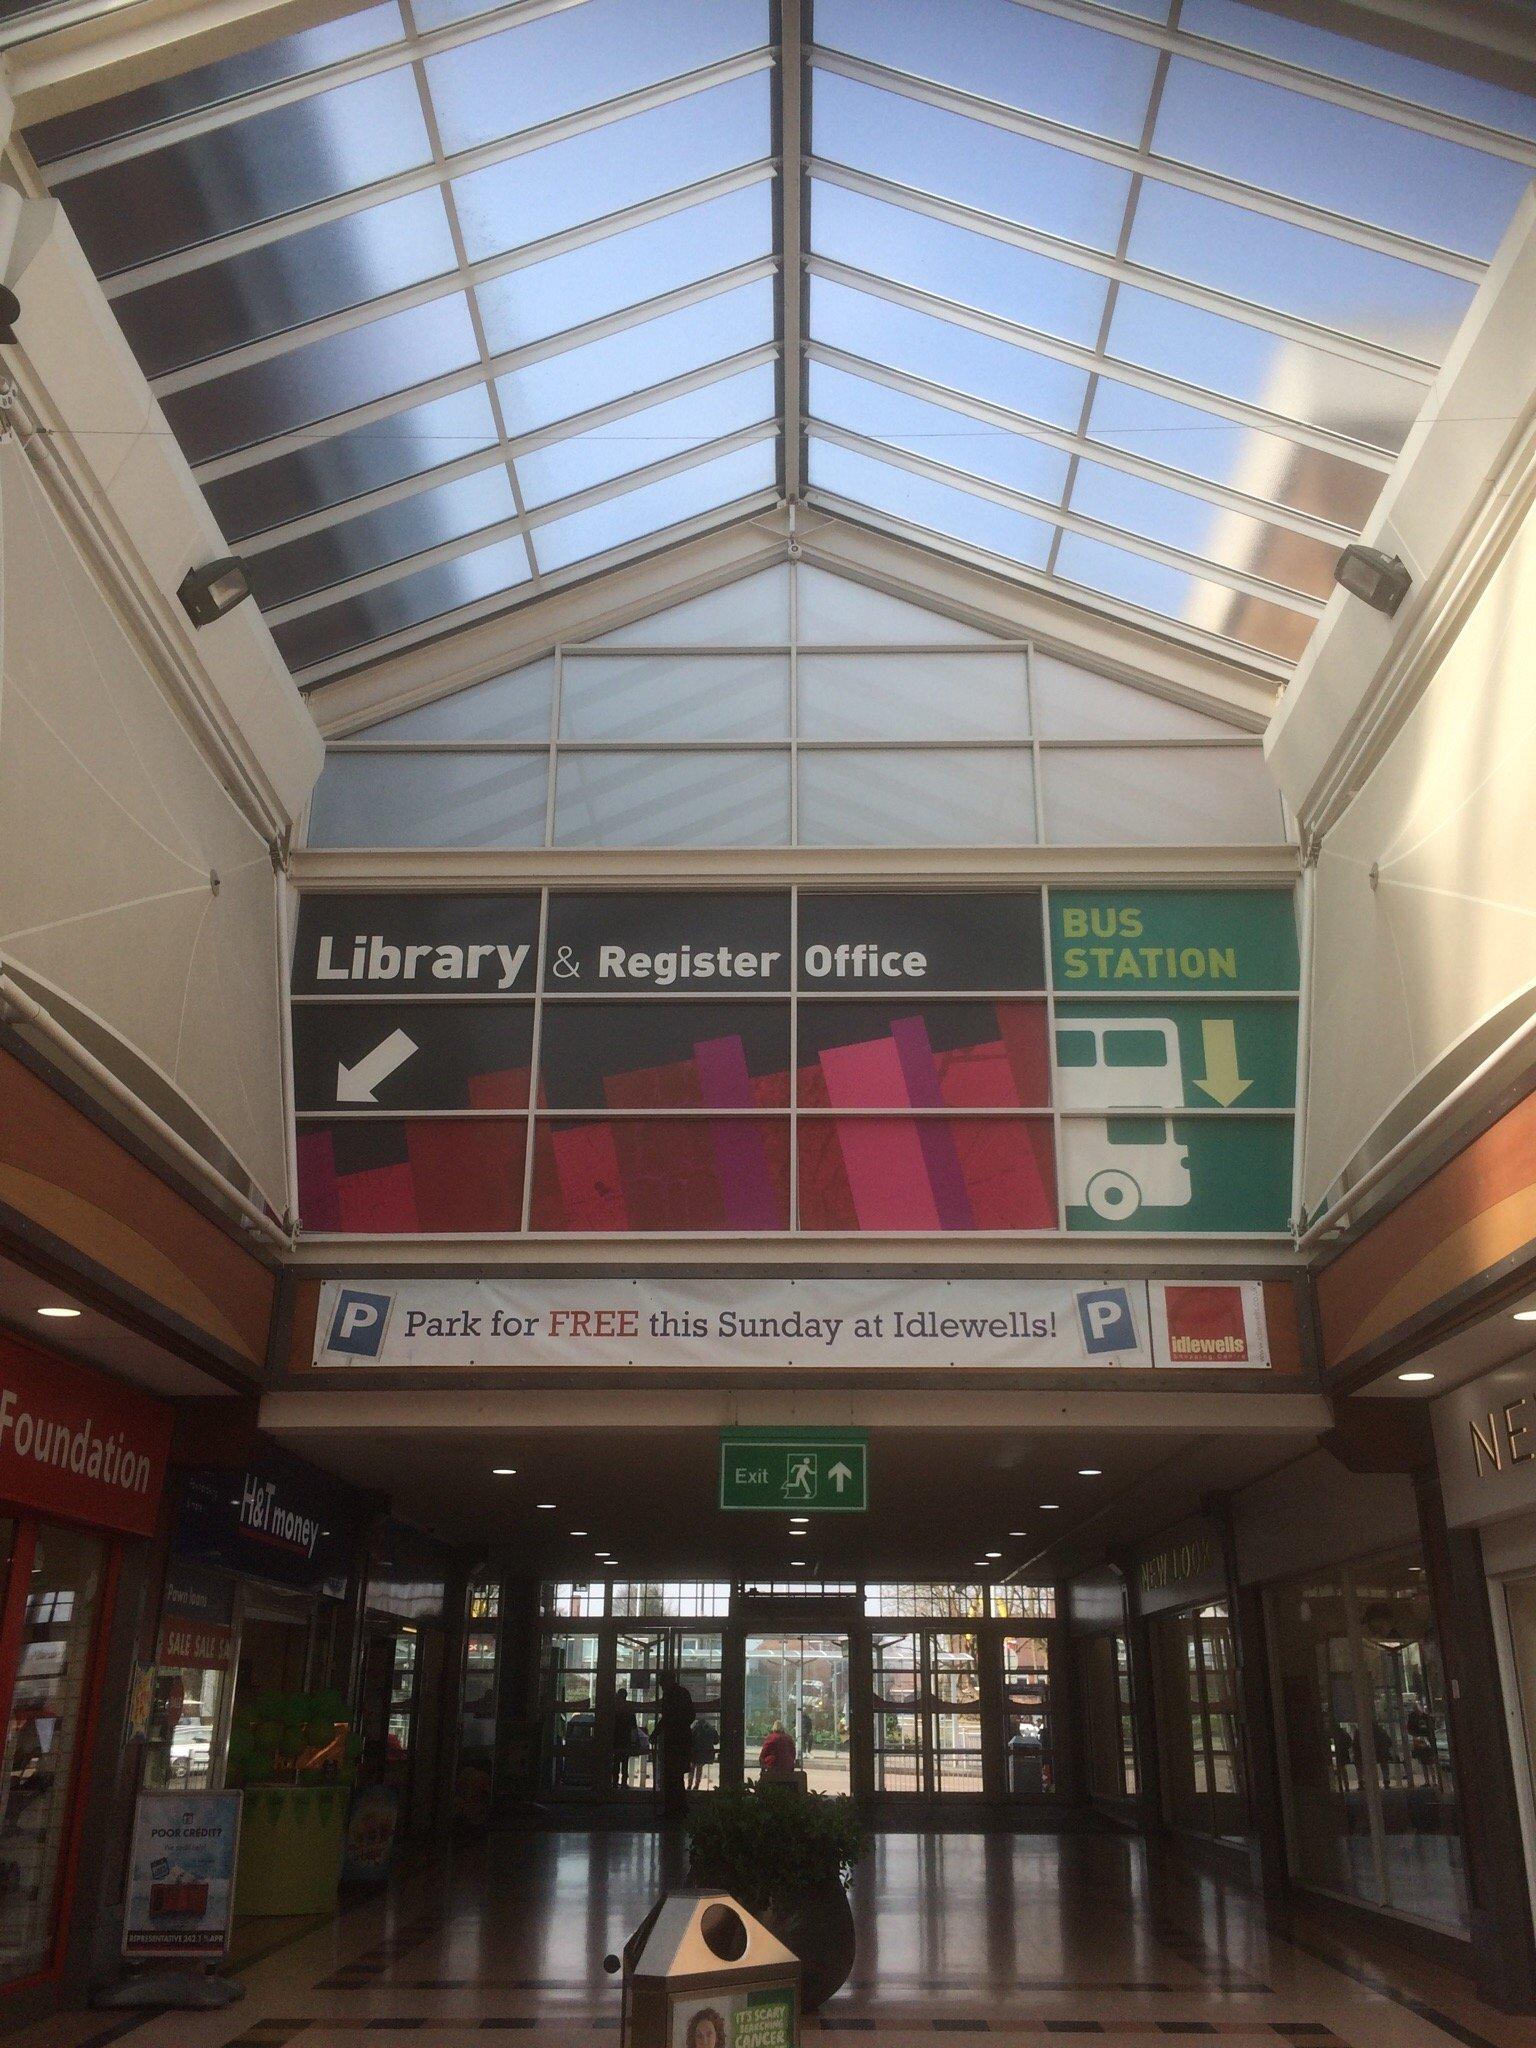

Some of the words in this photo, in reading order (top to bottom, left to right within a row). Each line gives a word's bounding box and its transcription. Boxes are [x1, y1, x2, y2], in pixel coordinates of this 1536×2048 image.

[1063, 907, 1144, 938] BUS
[316, 935, 531, 990] Library
[553, 945, 581, 979] &
[598, 944, 781, 986] Register
[804, 944, 928, 979] Office
[1063, 946, 1237, 979] STATION
[339, 1301, 379, 1339] P
[404, 1310, 482, 1338] Park
[491, 1309, 539, 1338] for
[548, 1310, 639, 1338] FREE
[650, 1309, 709, 1338] this
[718, 1309, 843, 1346] Sunday
[854, 1314, 883, 1338] at
[893, 1309, 1058, 1339] Idlewells!
[1087, 1301, 1123, 1340] P
[1171, 1335, 1245, 1354] idlewells
[0, 1389, 150, 1494] Foundation
[735, 1467, 769, 1486] Exit
[240, 1472, 276, 1531] H&T
[271, 1505, 319, 1559] money
[167, 1631, 191, 1656] SALE
[151, 1828, 181, 1838] POOR
[183, 1827, 222, 1838] CREDIT?
[754, 2005, 786, 2022] SCARY
[735, 2029, 785, 2048] CANCER
